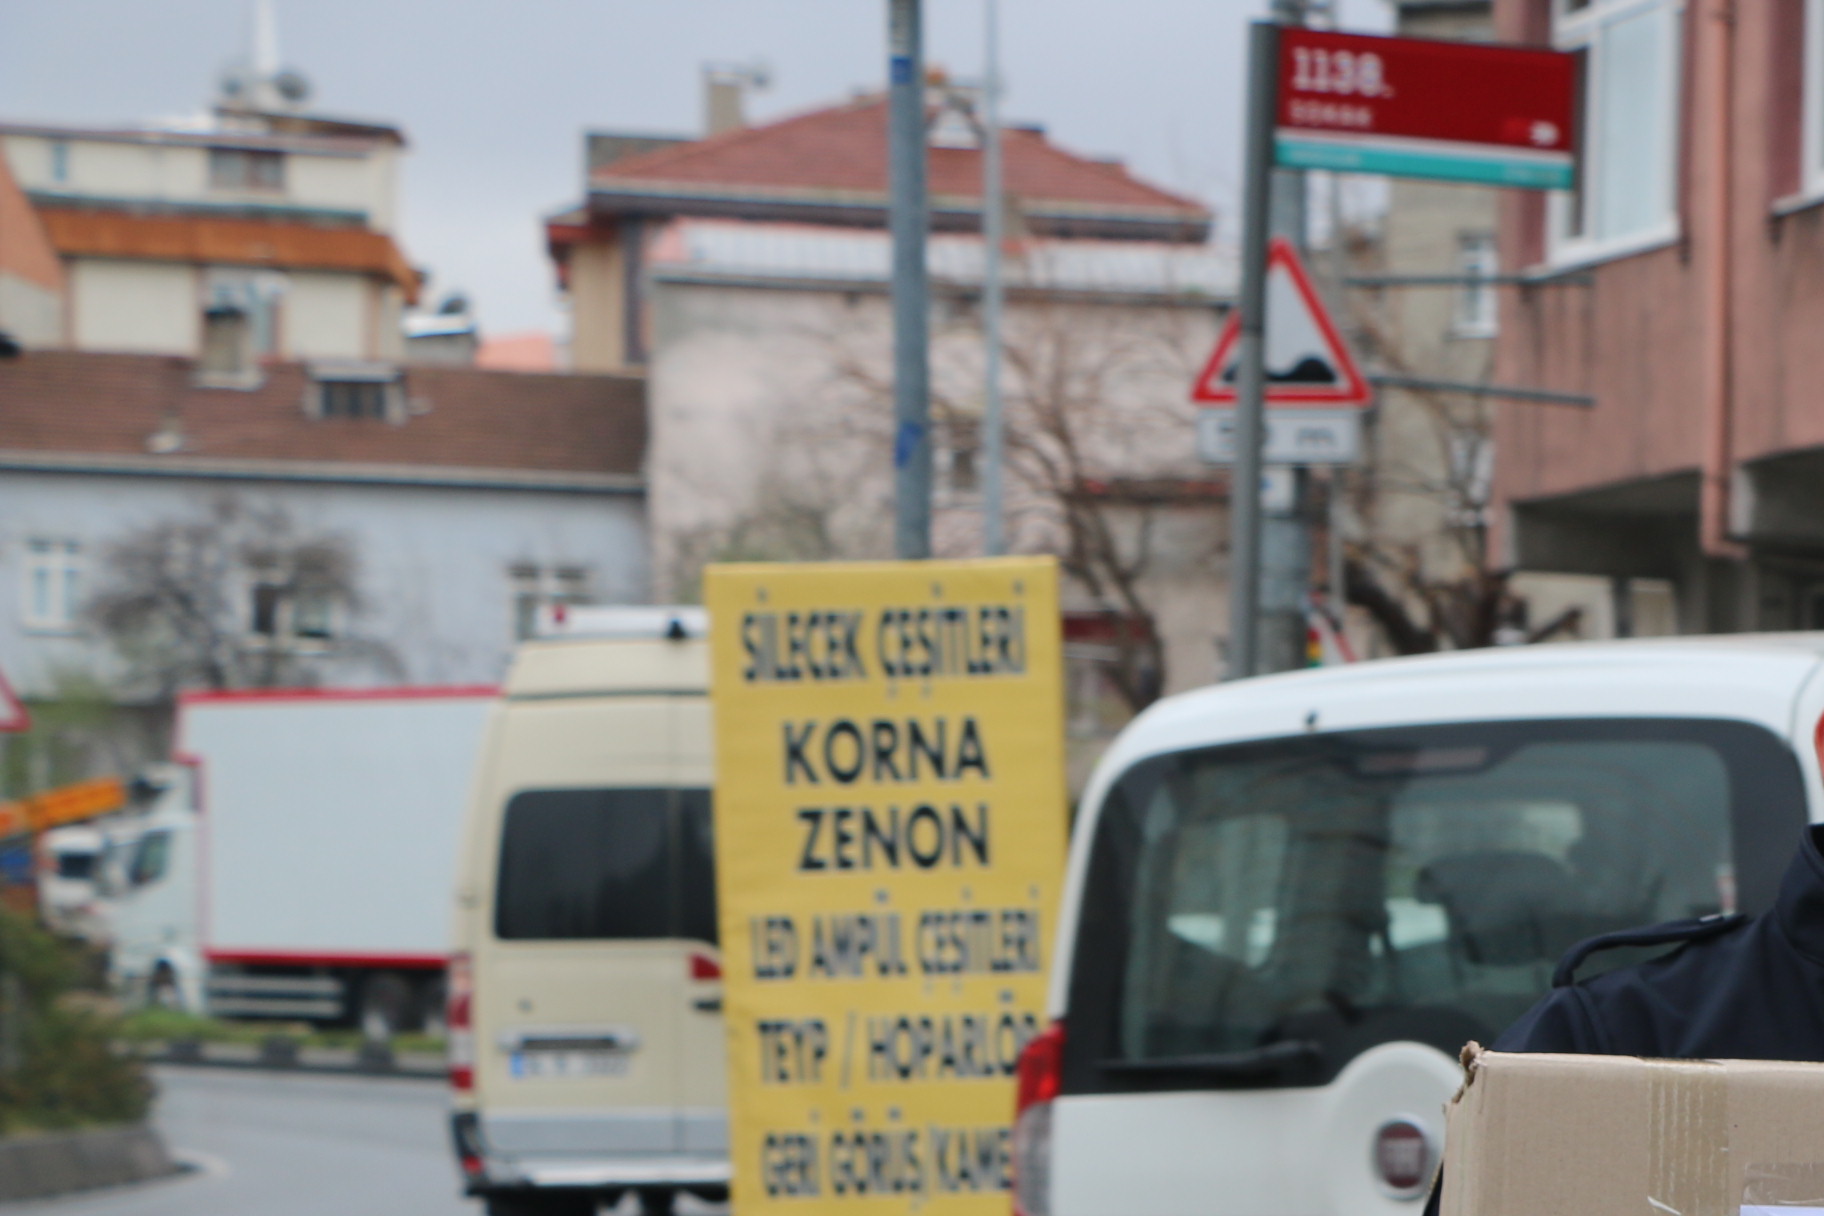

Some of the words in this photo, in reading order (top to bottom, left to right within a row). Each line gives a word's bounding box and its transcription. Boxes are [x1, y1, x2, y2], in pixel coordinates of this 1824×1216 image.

[741, 586, 867, 681] SİLECEK
[876, 581, 1027, 698] ÇEŞİTLERİ
[781, 716, 990, 785] KORNA
[796, 803, 990, 872] ZENON
[750, 914, 796, 980] LED
[809, 887, 908, 979] AMPÜL
[758, 1018, 828, 1083] TEYP
[762, 1109, 821, 1197] GERİ
